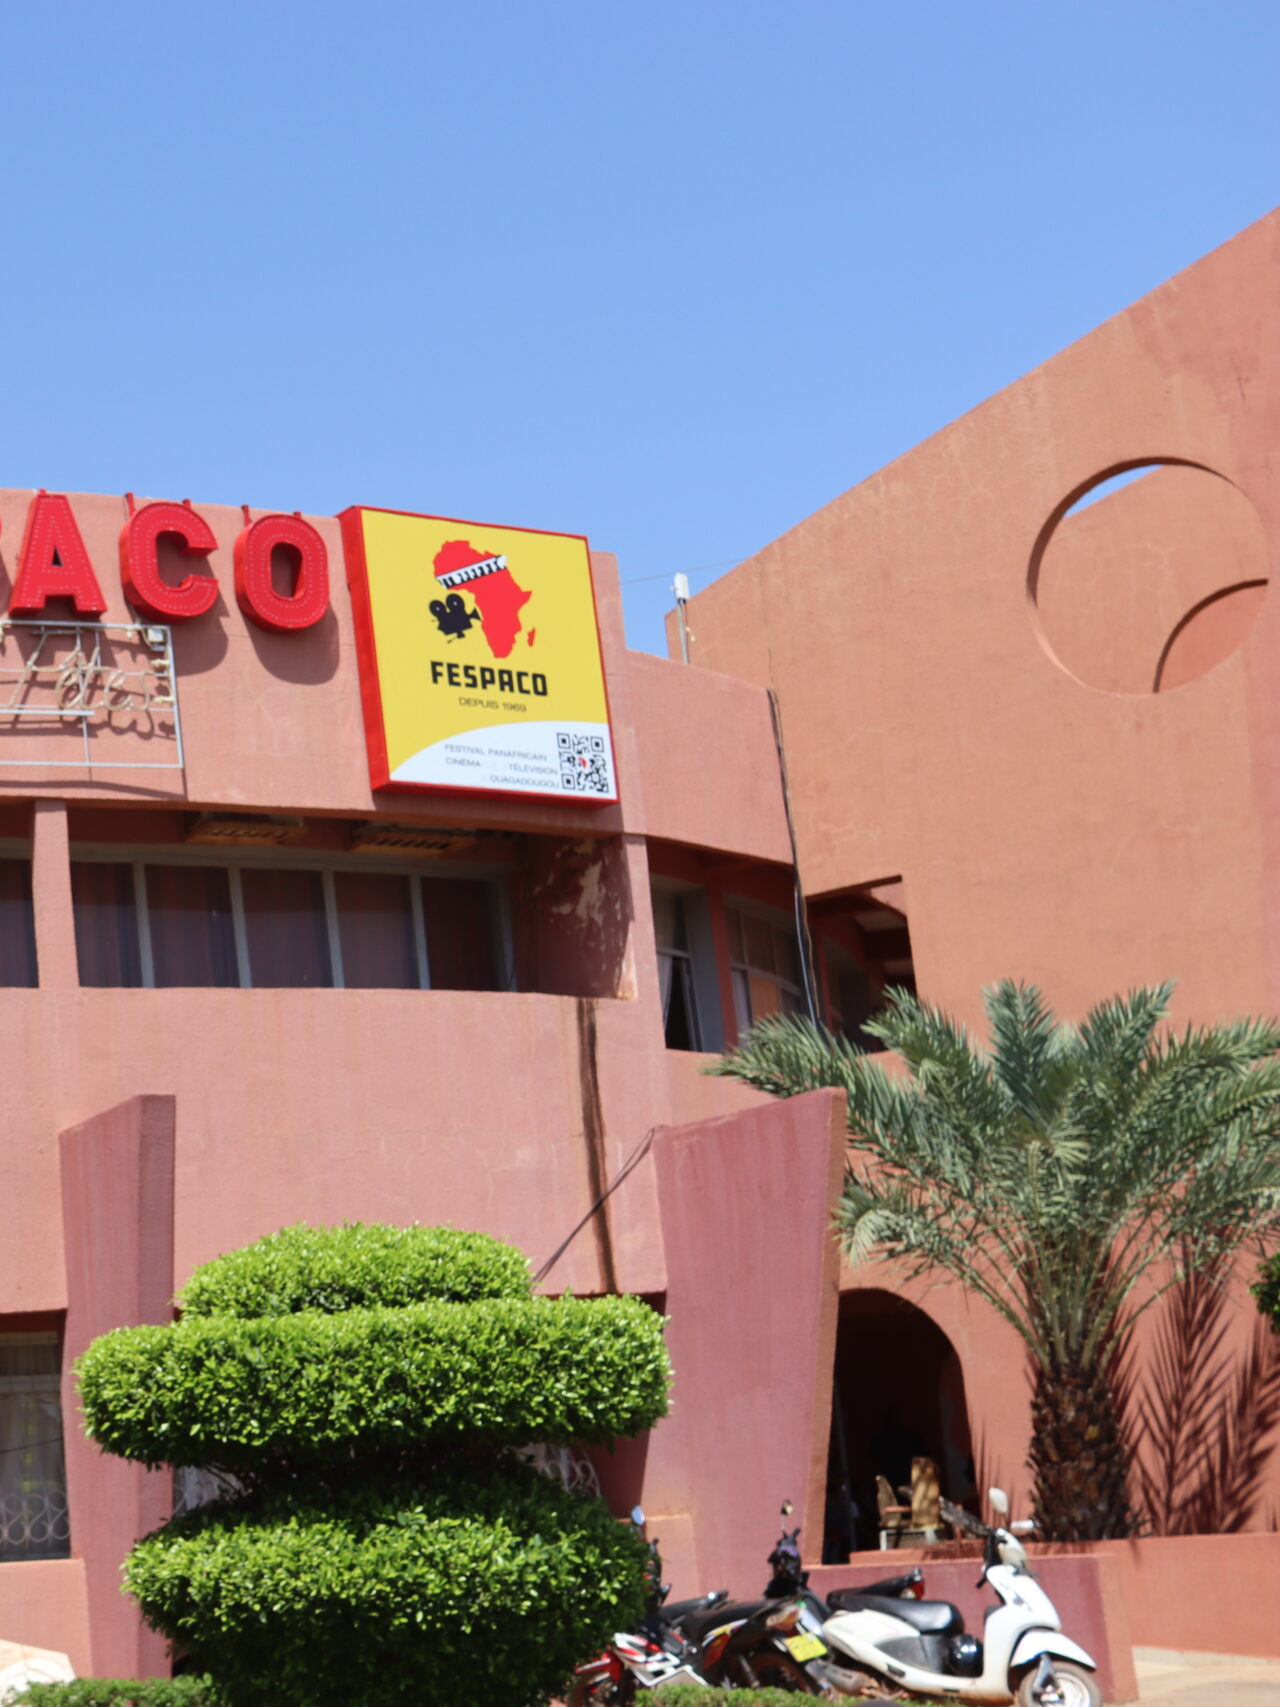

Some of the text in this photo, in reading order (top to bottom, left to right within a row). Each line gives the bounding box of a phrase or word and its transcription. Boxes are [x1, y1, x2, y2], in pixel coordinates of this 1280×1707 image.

[430, 660, 548, 697] FESPACO
[458, 697, 527, 712] DEPUIS 1969
[444, 744, 548, 761] FESTIVAL PANAFRICAIN
[489, 774, 560, 788] OUAGADOUGOU
